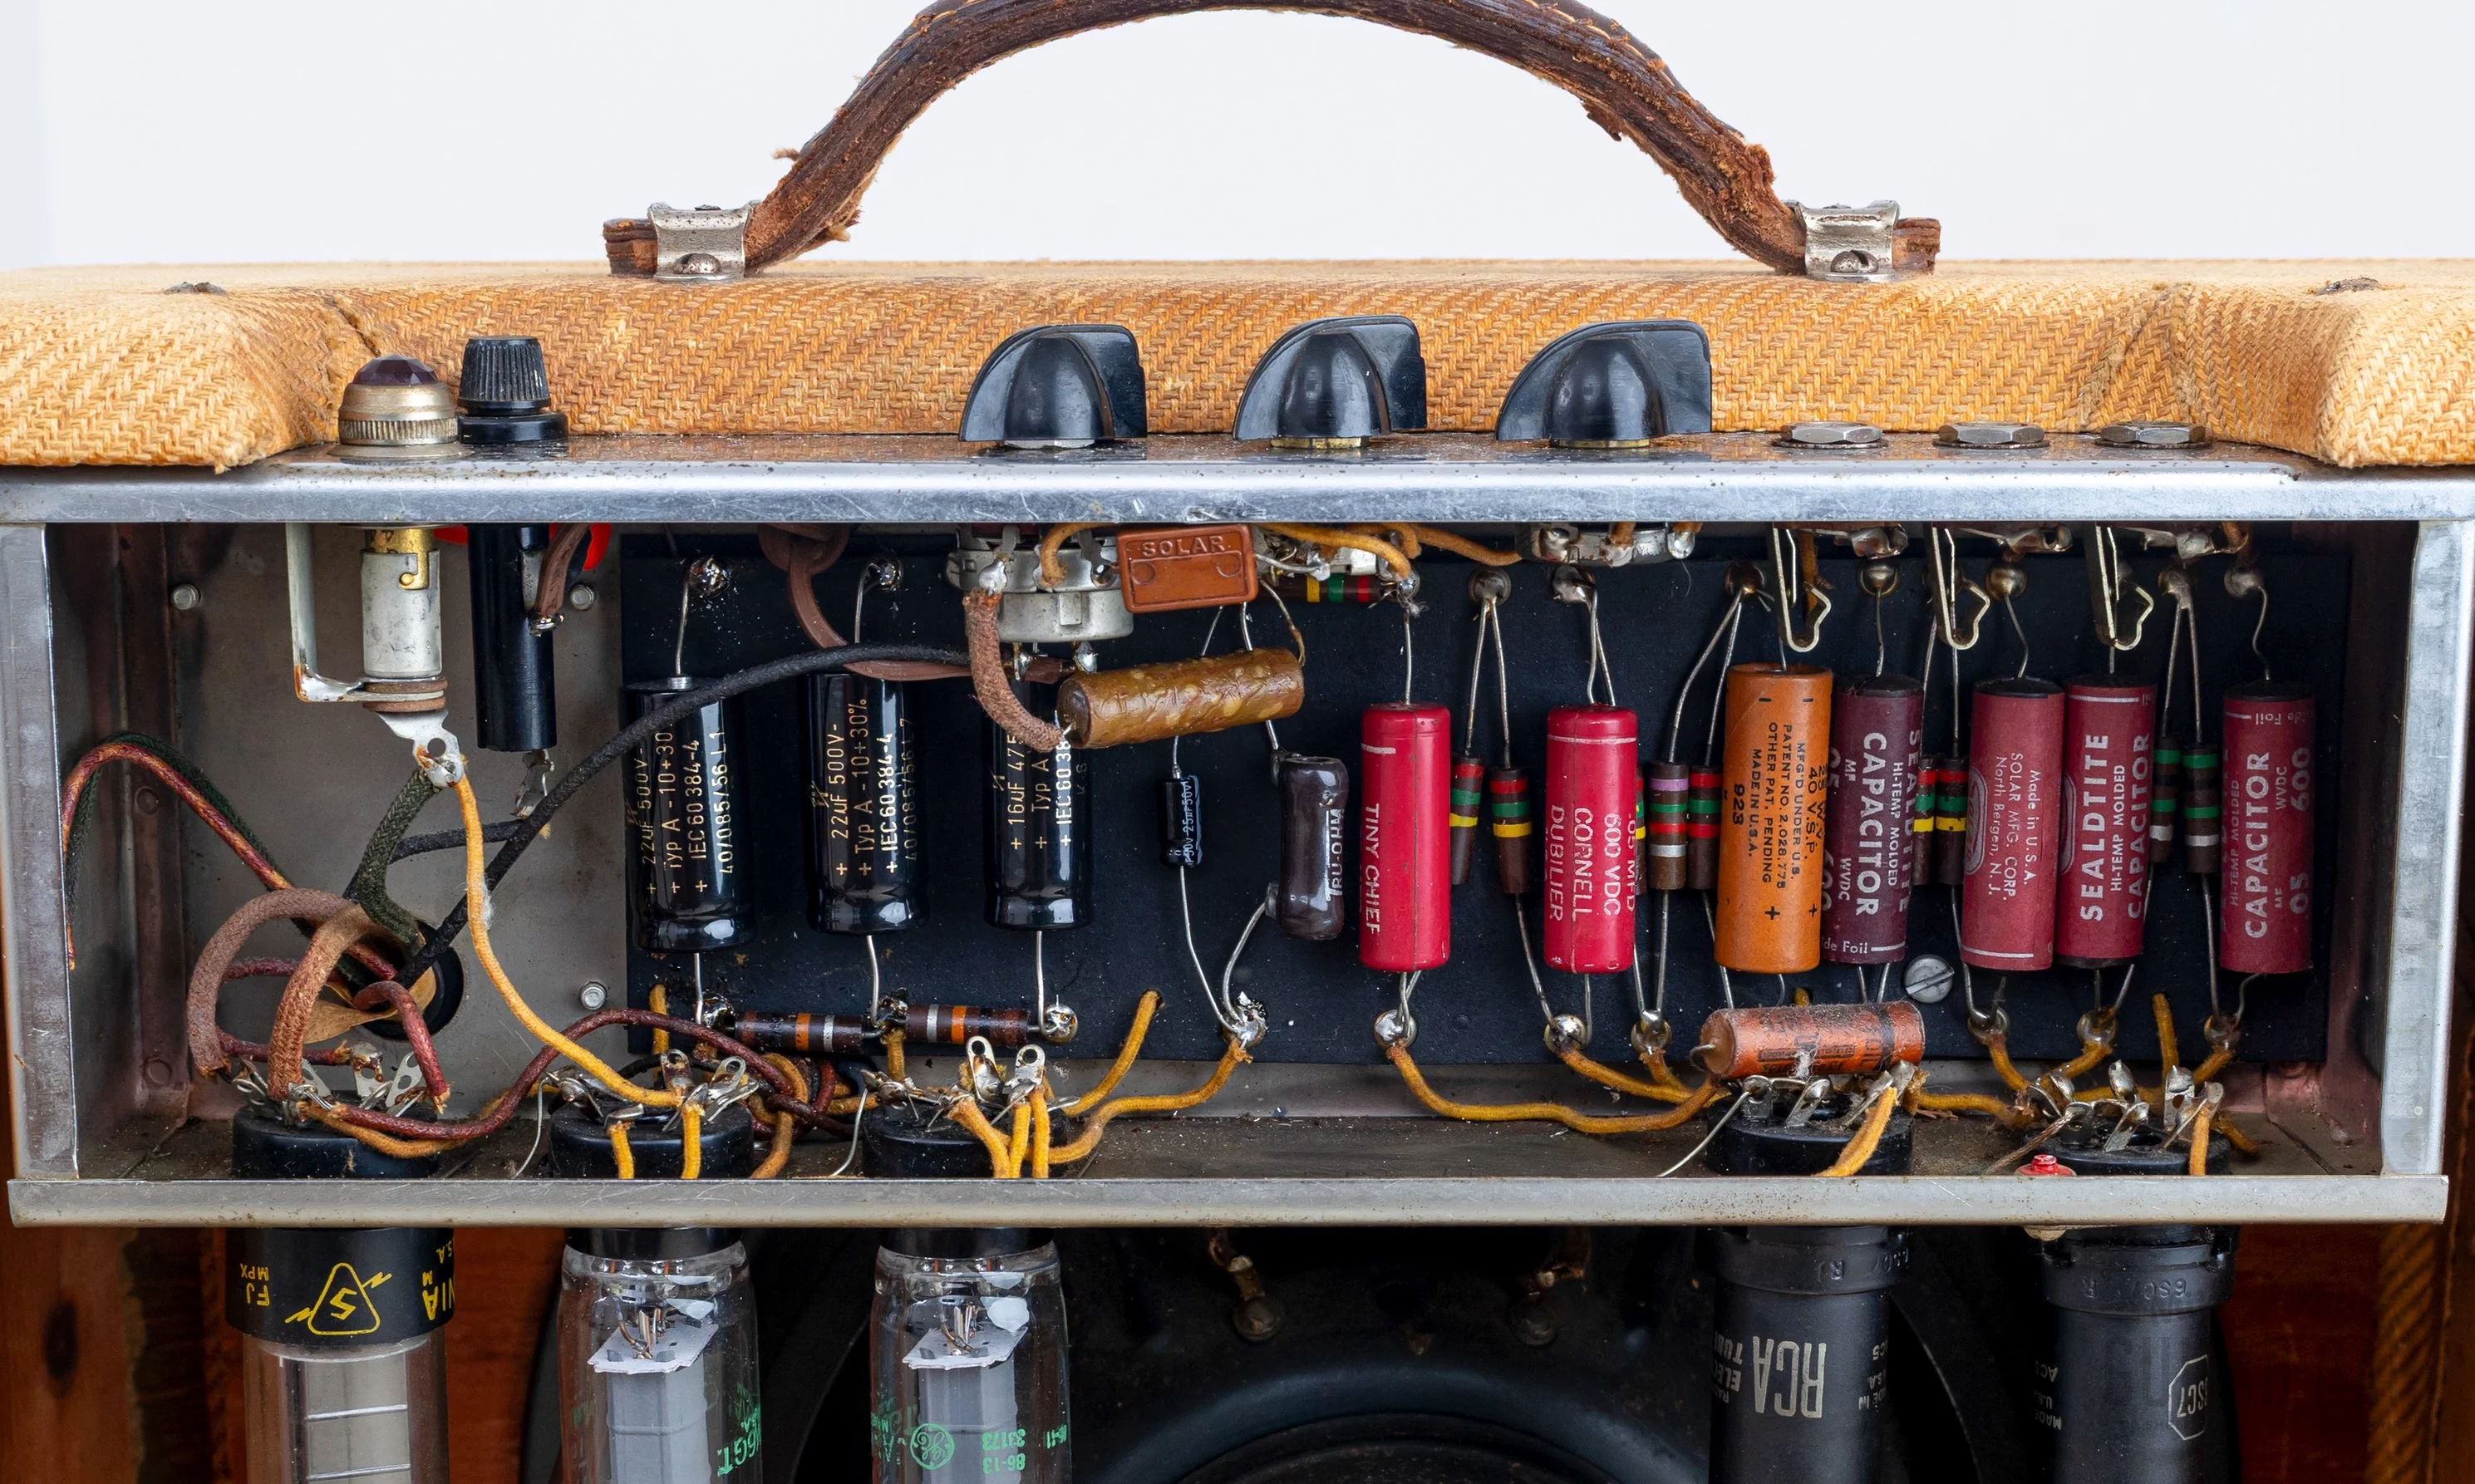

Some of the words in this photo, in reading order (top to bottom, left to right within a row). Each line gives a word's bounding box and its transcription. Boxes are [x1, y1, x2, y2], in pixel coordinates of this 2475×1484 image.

[1141, 534, 1226, 558] SOLAR
[2254, 712, 2282, 725] Foil
[1751, 749, 1762, 789] MADE
[1767, 721, 1778, 773] OTHER
[1781, 724, 1793, 782] PATENT
[1795, 742, 1806, 789] MFG'D
[1031, 783, 1051, 812] Typ
[1764, 777, 1775, 810] PAT.
[1779, 785, 1790, 812] NO.
[1807, 766, 1818, 794] 40
[1890, 761, 1904, 819] HI-TEMP
[1993, 756, 2008, 798] North
[2008, 752, 2024, 803] SOLAR
[2026, 769, 2042, 810] Made
[2112, 764, 2126, 827] MOLDED
[2275, 765, 2288, 811] WVDC
[2290, 746, 2310, 812] 600
[711, 763, 733, 874] 40/085/56
[854, 799, 873, 814] A
[1732, 783, 1745, 826] 923
[1749, 793, 1760, 809] IN
[1793, 795, 1803, 847] UNDER
[1855, 732, 1887, 916] CAPACITOR
[1898, 729, 1921, 913] SEALDTITE
[2025, 816, 2040, 830] in
[2230, 779, 2241, 842] MOLDED
[854, 823, 875, 854] Typ
[1365, 803, 1380, 859] TINY
[1603, 813, 1621, 858] 600
[1989, 803, 2005, 857] Bergen,
[2005, 809, 2020, 848] MFG.
[2079, 734, 2110, 921] SEALDTITE
[2127, 732, 2150, 920] CAPACITOR
[2244, 750, 2271, 939] CAPACITOR
[666, 842, 683, 869] Typ
[1549, 804, 1566, 922] DUBILIER
[1572, 807, 1594, 922] CORNELL
[1762, 817, 1774, 884] PENDING
[1789, 852, 1801, 881] U.S.
[1887, 826, 1900, 887] MOLDED
[2023, 836, 2039, 885] U.S.A.
[2110, 833, 2124, 892] HI-TEMP
[1365, 863, 1381, 936] CHIEF
[1603, 864, 1621, 916] VDC
[1838, 857, 1852, 902] WVDC
[2002, 856, 2018, 902] CORP.
[1843, 940, 1869, 955] Foil
[239, 1262, 269, 1281] MPX
[246, 1282, 271, 1307] FJ
[1751, 1334, 1828, 1419] RCA
[982, 1452, 1026, 1475] 86-13
